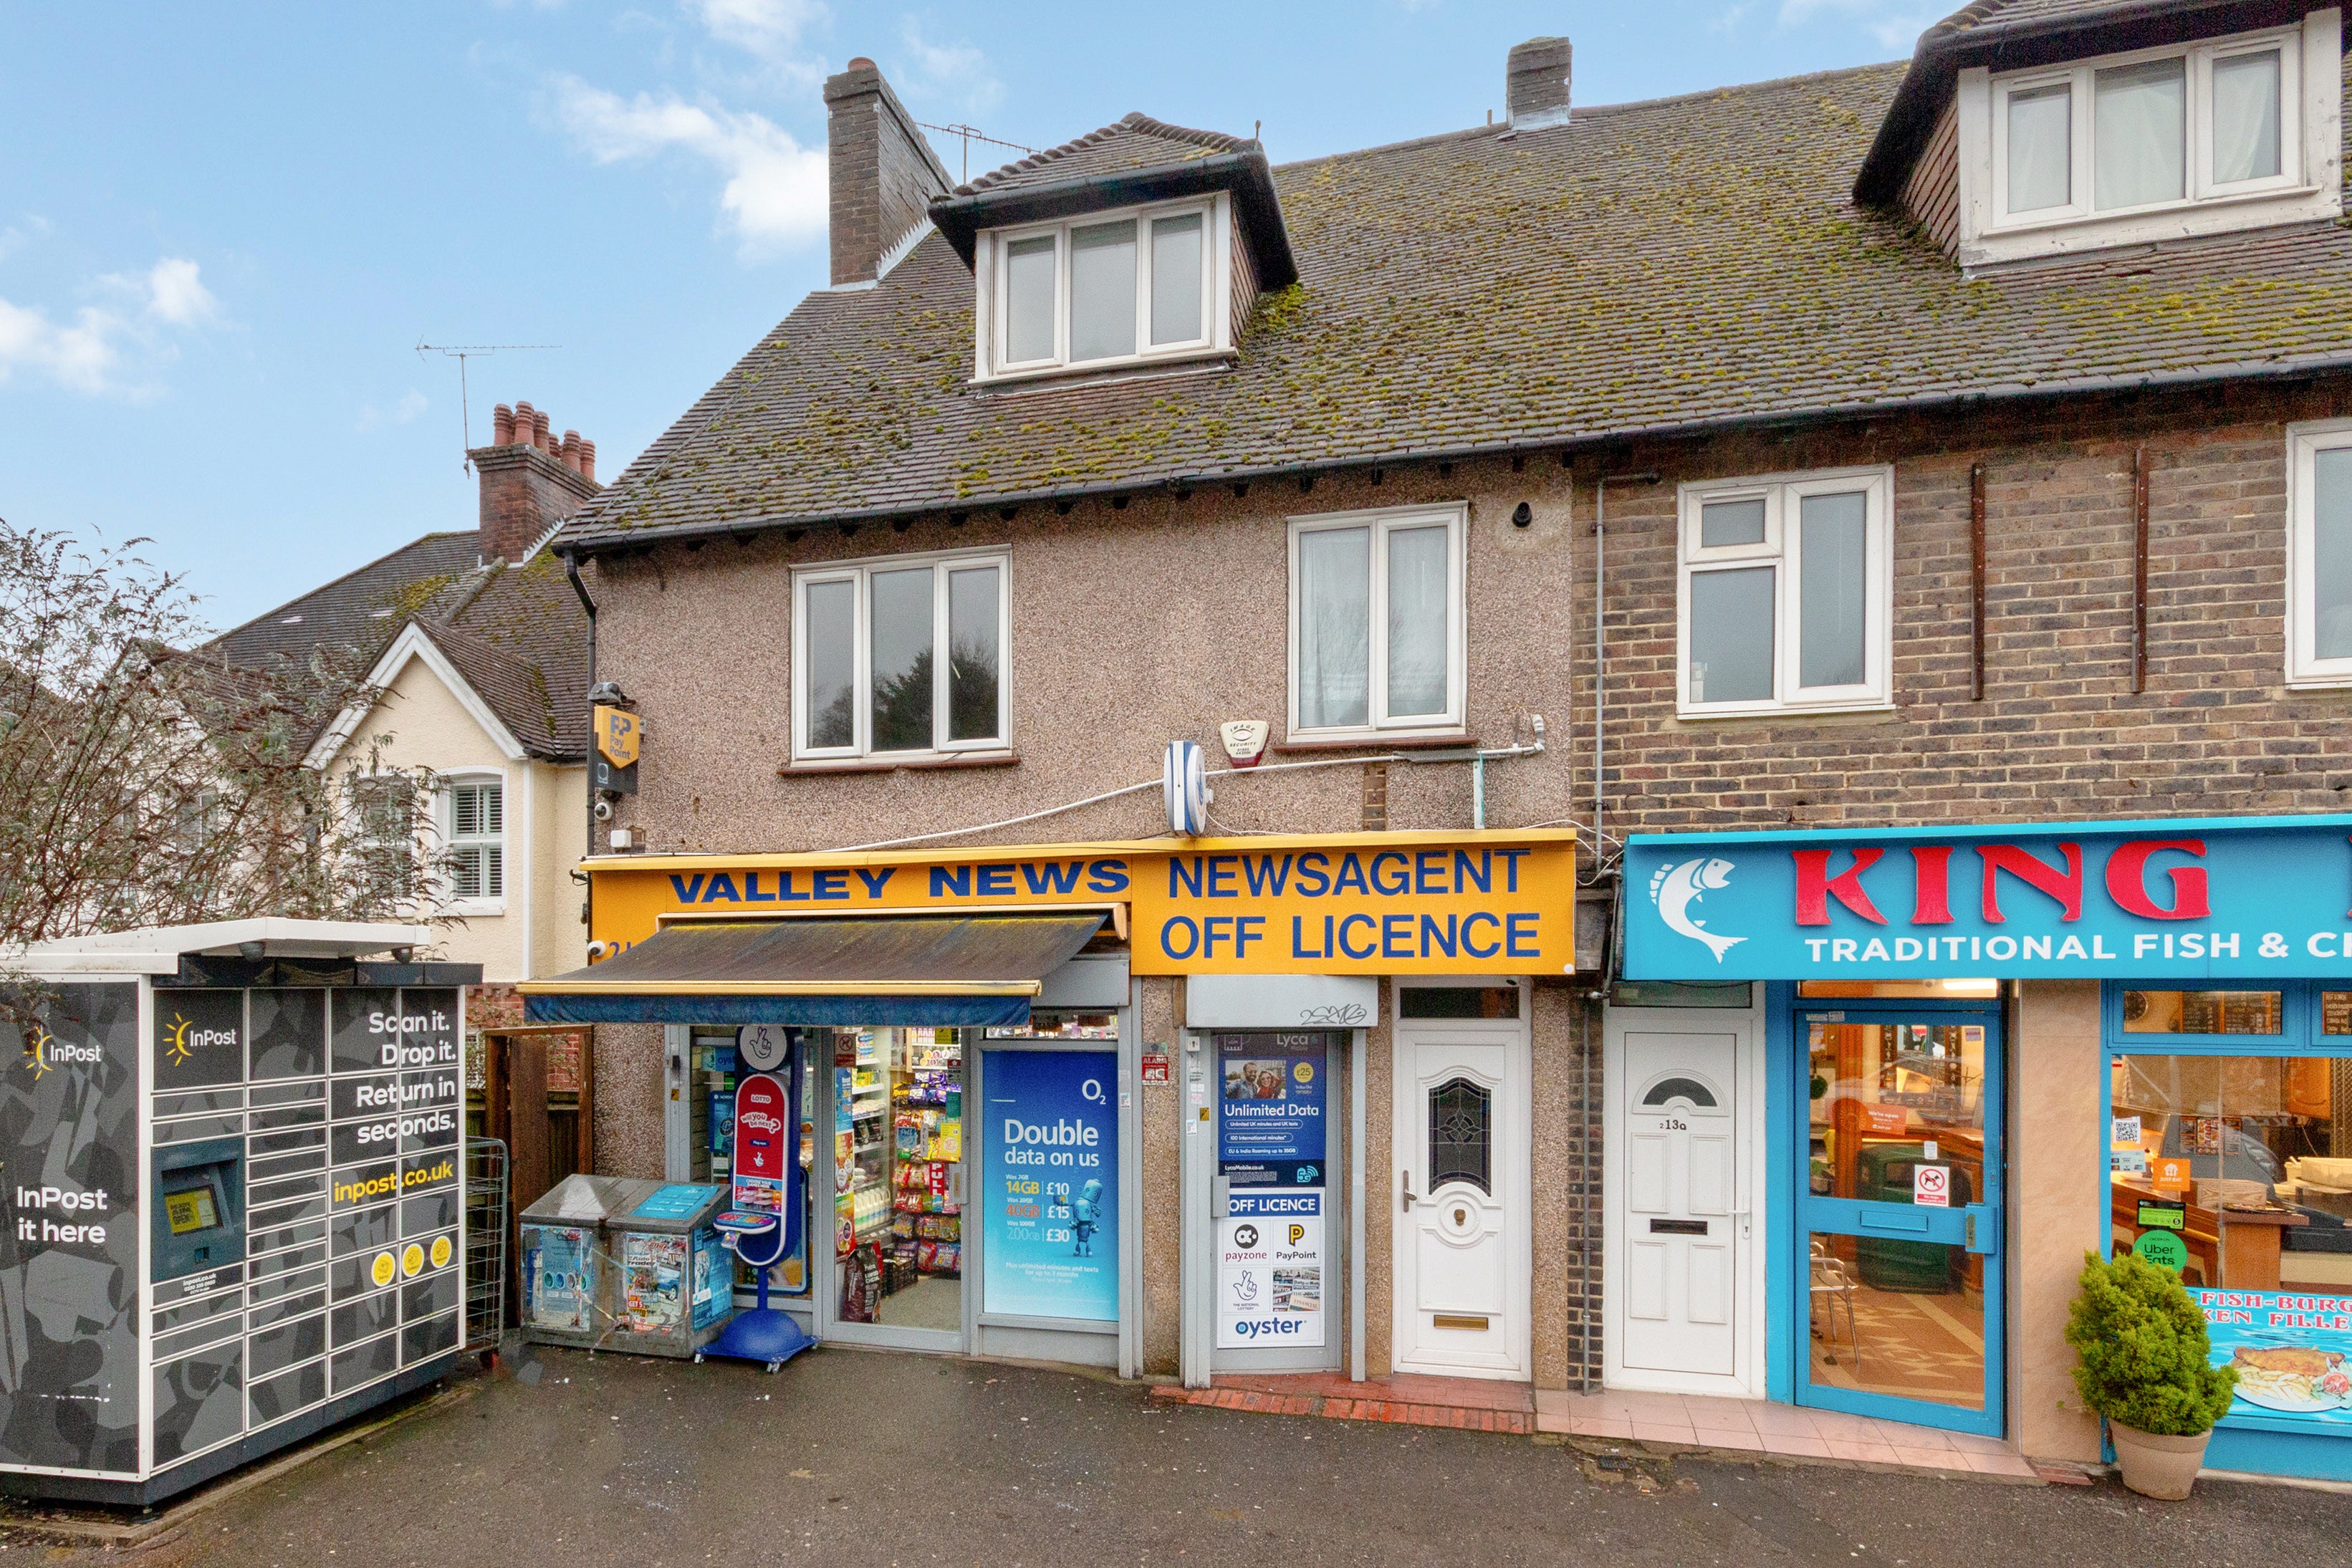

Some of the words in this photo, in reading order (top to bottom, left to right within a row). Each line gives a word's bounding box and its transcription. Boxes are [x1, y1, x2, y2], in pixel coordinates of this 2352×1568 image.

[610, 735, 624, 749] Pay
[609, 746, 630, 759] Point
[668, 867, 897, 903] VALLEY
[929, 860, 1130, 897] NEWS
[1168, 849, 1532, 898] NEWSAGENT
[1791, 839, 2212, 925] KING
[1161, 915, 1267, 960] OFF
[1292, 912, 1541, 959] LICENCE
[1805, 935, 2116, 962] TRADITIONAL
[2133, 933, 2240, 959] FISH
[2258, 932, 2289, 958] &
[369, 1012, 427, 1033] Scan
[432, 1010, 450, 1031] it.
[190, 1029, 236, 1047] InPost
[1277, 1033, 1308, 1047] Lyca
[50, 1045, 102, 1062] InPost
[382, 1044, 435, 1067] Drop
[439, 1040, 456, 1061] it.
[1297, 1068, 1311, 1077] £25
[357, 1078, 434, 1107] Return
[438, 1076, 455, 1097] in
[1082, 1079, 1106, 1105] O2
[1224, 1104, 1285, 1117] Unlimited
[1289, 1105, 1319, 1116] Data
[357, 1112, 456, 1144] seconds.
[1004, 1118, 1098, 1146] Double
[1659, 1119, 1687, 1130] 213a
[1004, 1146, 1045, 1165] data
[1050, 1152, 1073, 1165] on
[1079, 1153, 1099, 1167] us
[334, 1160, 453, 1203] inpost.co.uk
[1006, 1180, 1040, 1195] 14GB
[1046, 1182, 1070, 1195] £10
[17, 1186, 107, 1210] InPost
[1229, 1199, 1255, 1212] OFF
[1259, 1198, 1315, 1211] LICENCE
[1005, 1204, 1040, 1217] 40GB
[1047, 1206, 1070, 1218] £15
[19, 1218, 37, 1241] it
[43, 1219, 106, 1244] here
[1047, 1228, 1070, 1242] £30
[1226, 1252, 1267, 1262] payzone
[1276, 1251, 1317, 1260] PayPoint
[2144, 1244, 2175, 1254] Uber
[2145, 1254, 2175, 1265] Eats
[183, 1273, 216, 1286] inpost.co.uk
[1235, 1317, 1302, 1339] oyster
[2269, 1313, 2352, 1330] FILLE
